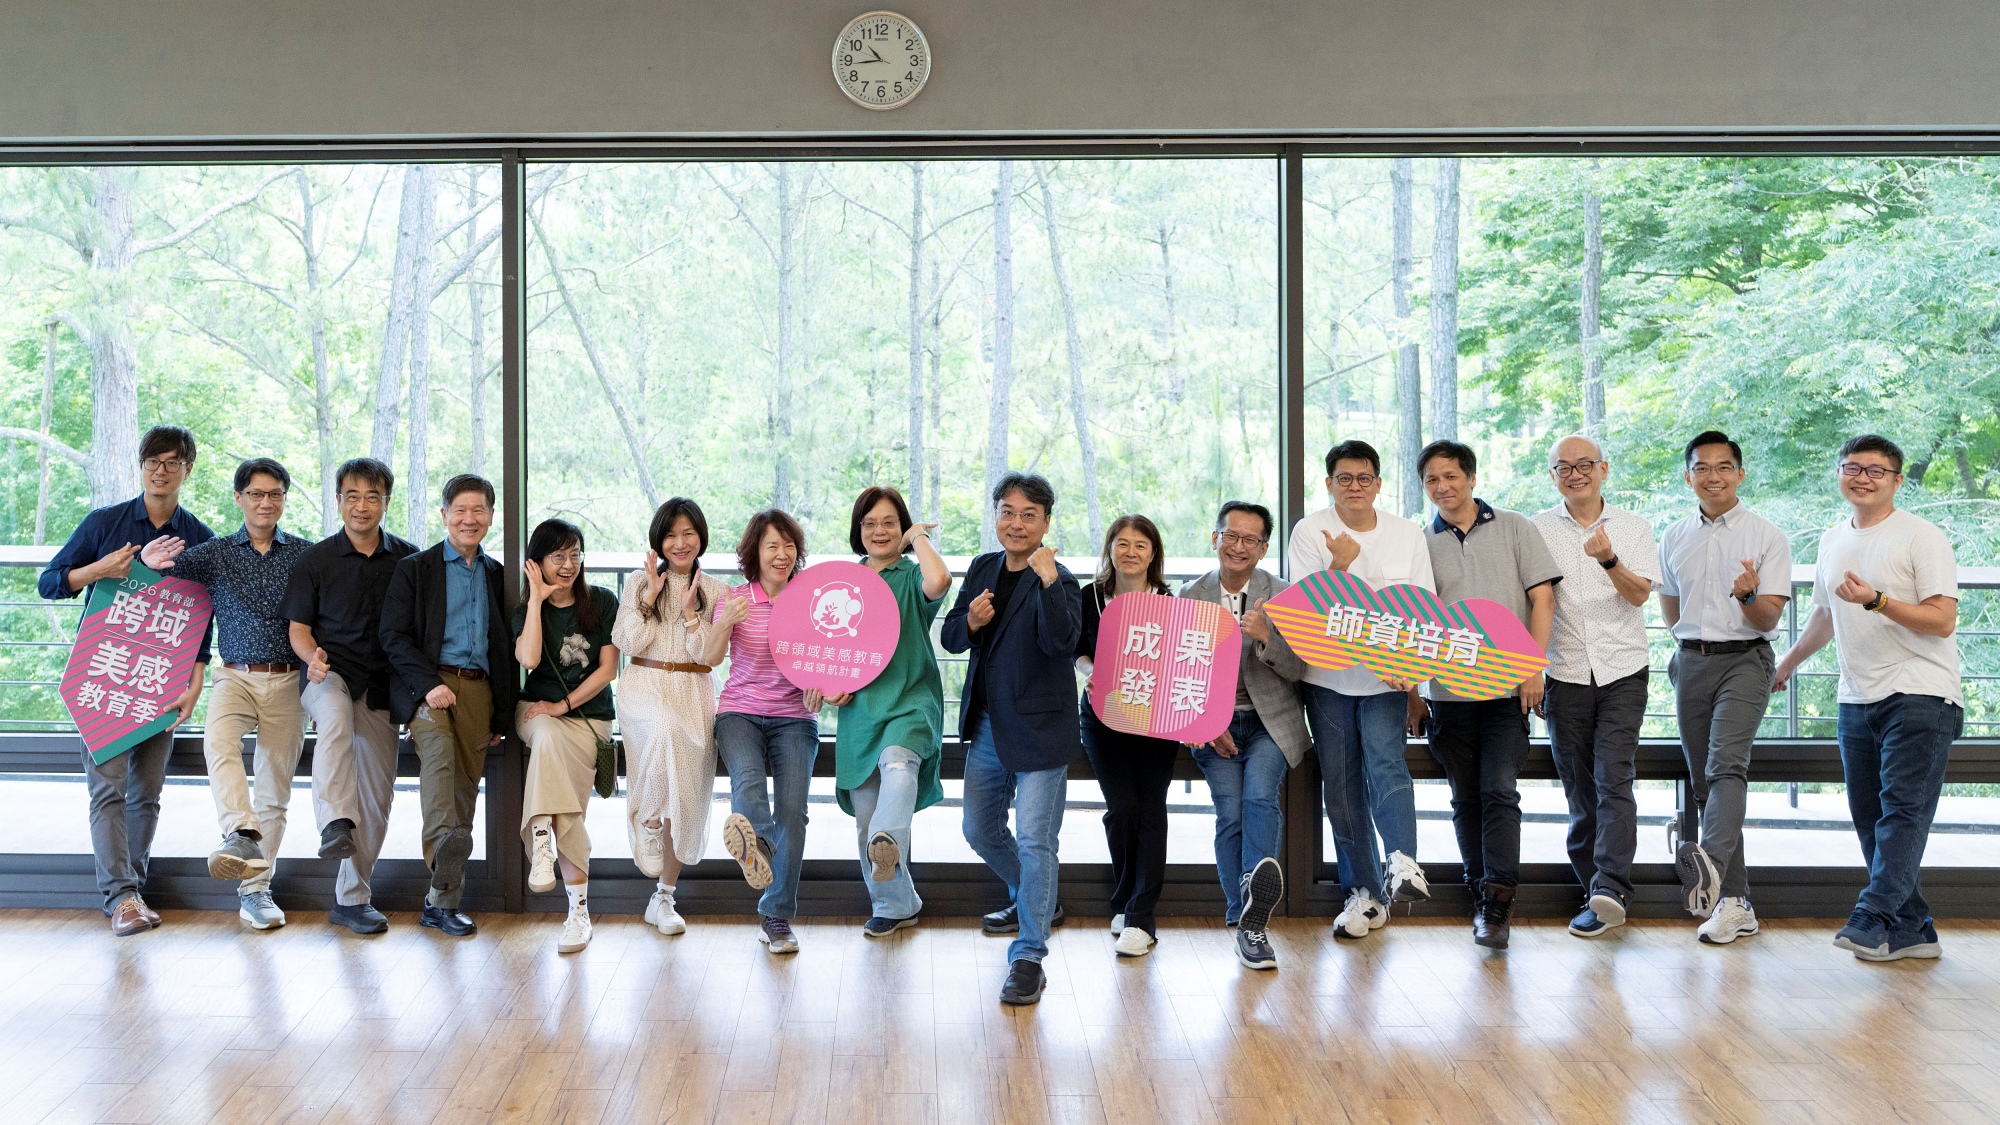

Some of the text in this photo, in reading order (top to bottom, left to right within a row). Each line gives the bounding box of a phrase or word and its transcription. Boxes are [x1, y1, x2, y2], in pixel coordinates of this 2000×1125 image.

[861, 28, 871, 39] 11
[875, 24, 888, 35] 12
[897, 28, 901, 39] 1
[849, 40, 862, 51] 10
[905, 39, 913, 50] 2
[844, 55, 852, 66] 9
[910, 55, 918, 66] 3
[849, 70, 858, 82] 8
[905, 71, 913, 82] 4
[861, 81, 869, 92] 7
[877, 86, 885, 97] 6
[894, 82, 902, 93] 5
[119, 576, 196, 608] 2026 教育部
[105, 590, 191, 648] 跨域
[1325, 602, 1484, 667] 師資培育
[1123, 622, 1213, 667] 成果
[775, 640, 883, 666] 跨領域美感教育
[87, 641, 173, 696] 美感
[792, 660, 861, 678] 卓越領航計畫
[1120, 667, 1207, 715] 發表
[77, 681, 159, 724] 教育季
